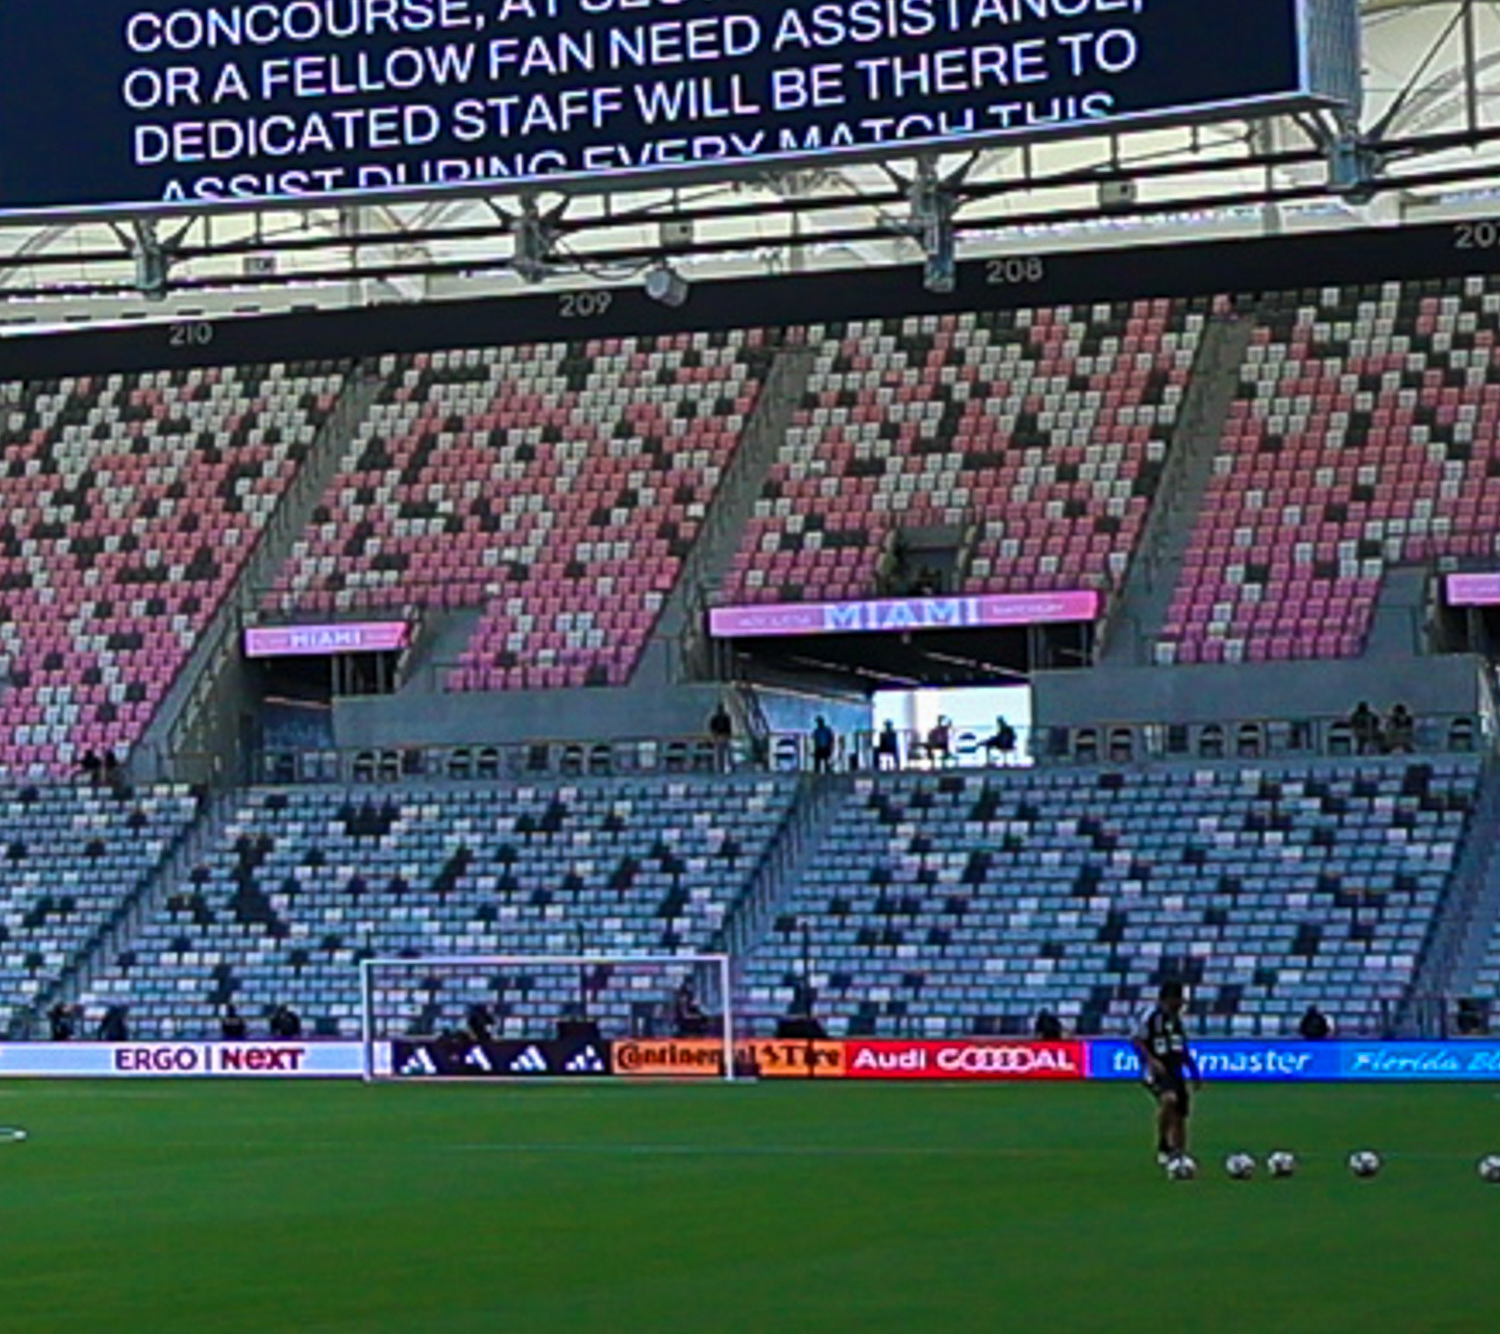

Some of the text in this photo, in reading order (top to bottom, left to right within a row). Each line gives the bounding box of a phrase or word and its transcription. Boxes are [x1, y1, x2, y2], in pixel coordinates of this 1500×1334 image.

[124, 67, 199, 108] OR
[214, 64, 249, 103] A
[263, 43, 474, 98] FELLOW
[490, 31, 593, 79] FAN
[611, 16, 760, 67] NEED
[136, 29, 1135, 164] DEDICATED STAFF WILL BE THERE TO
[986, 257, 1043, 284] 208
[560, 292, 611, 318] 209
[170, 322, 213, 347] 210
[824, 598, 979, 629] MIAMI
[290, 630, 361, 647] MIAMI
[115, 1047, 197, 1070] ERGO
[854, 1047, 926, 1071] Audi
[1351, 1048, 1460, 1072] Florida
